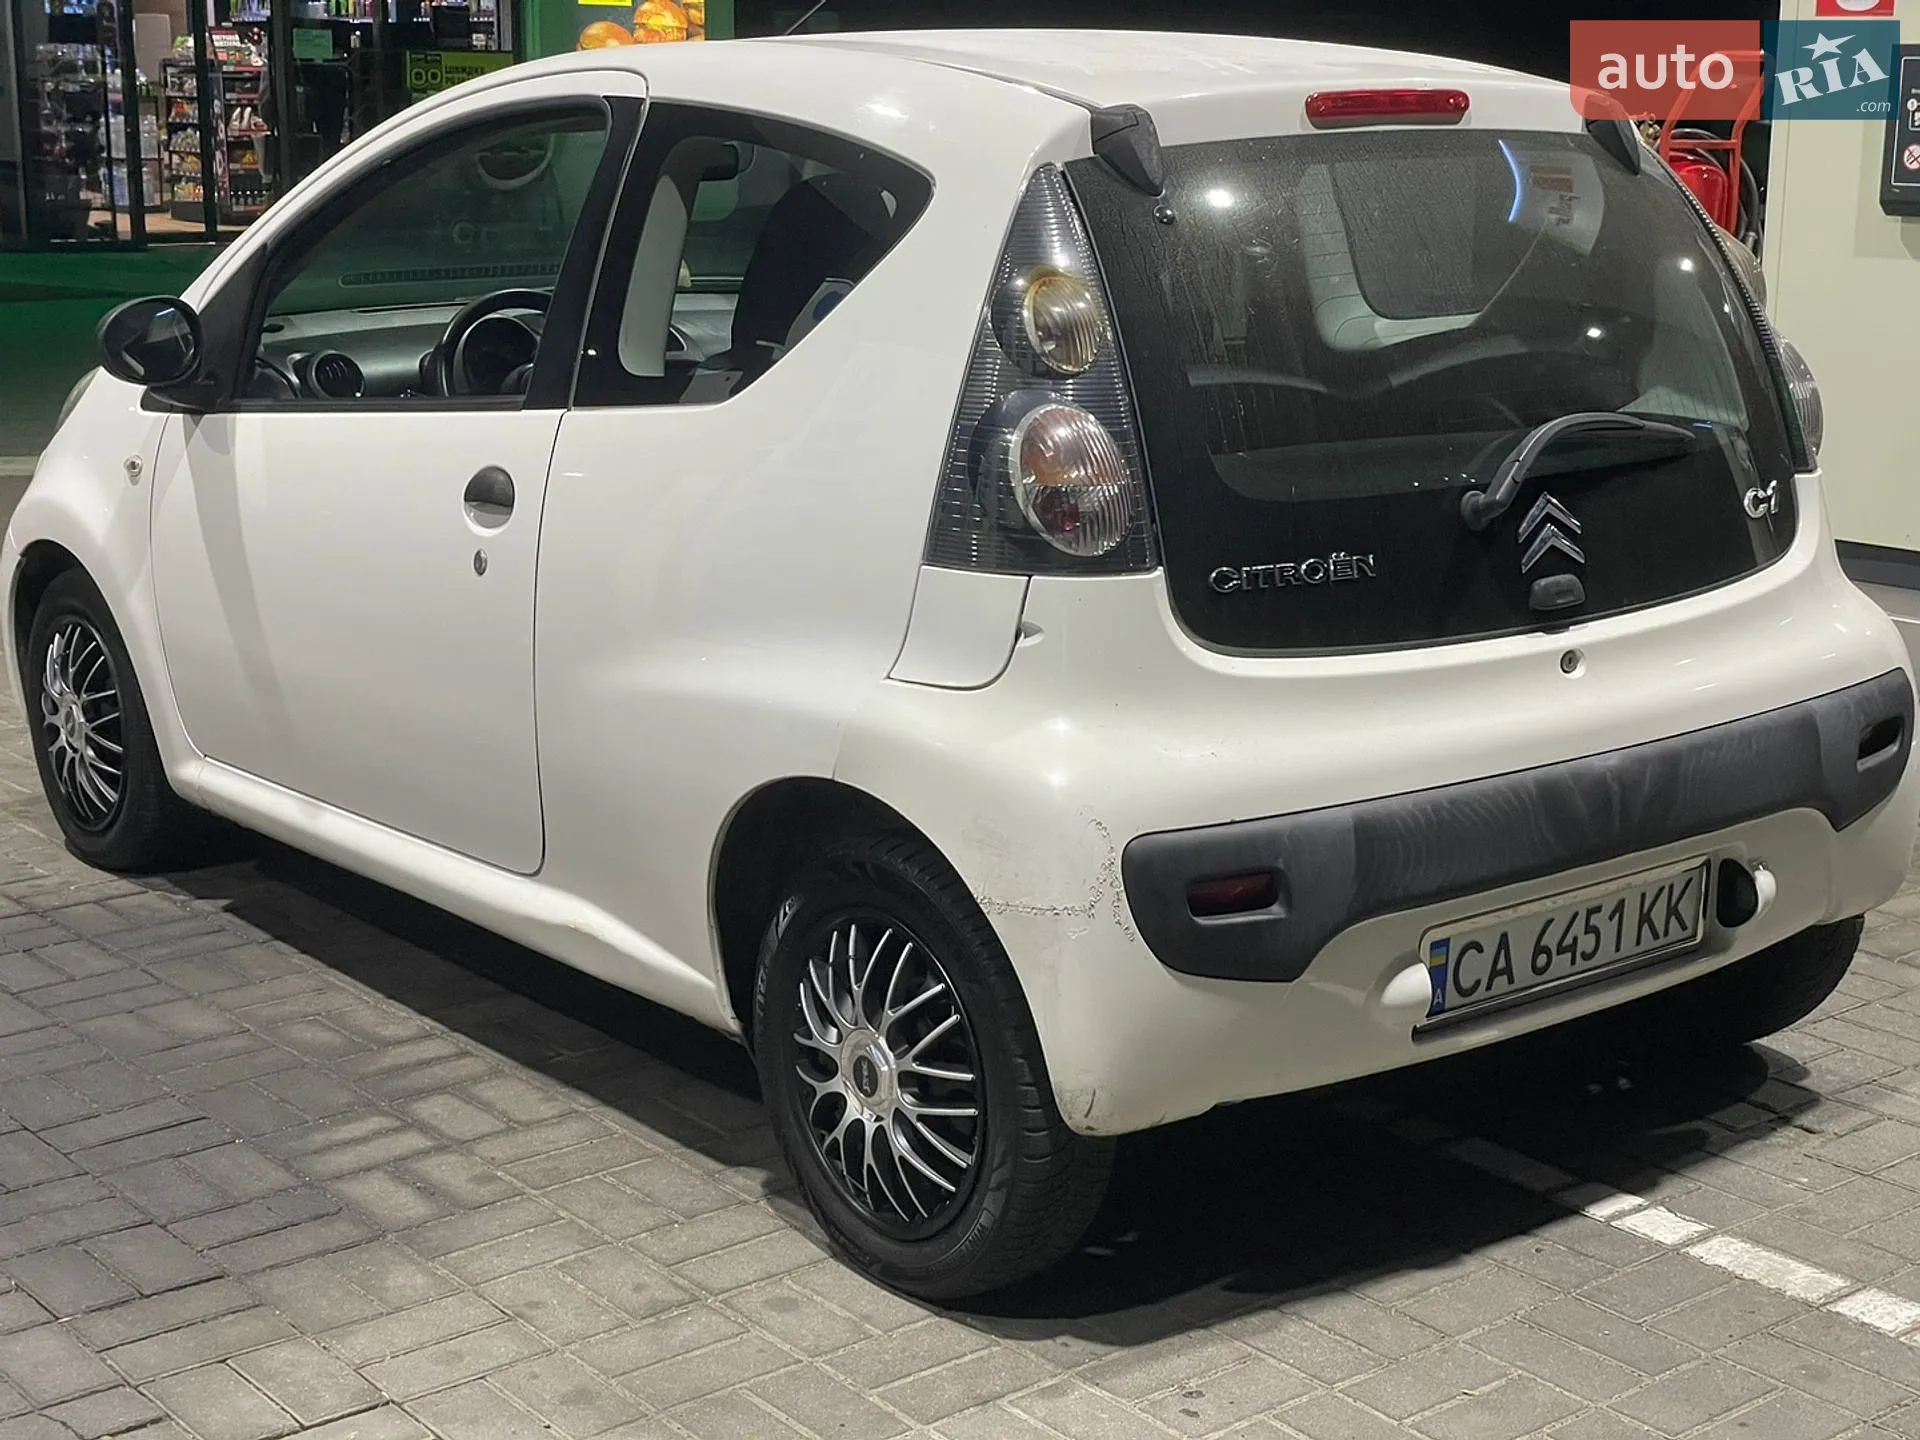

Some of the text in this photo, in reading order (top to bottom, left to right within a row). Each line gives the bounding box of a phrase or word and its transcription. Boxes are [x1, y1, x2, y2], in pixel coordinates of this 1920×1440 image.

[1744, 480, 1780, 518] C1
[1209, 551, 1376, 593] CITROËN
[1453, 876, 1694, 998] CA 6451 KK
